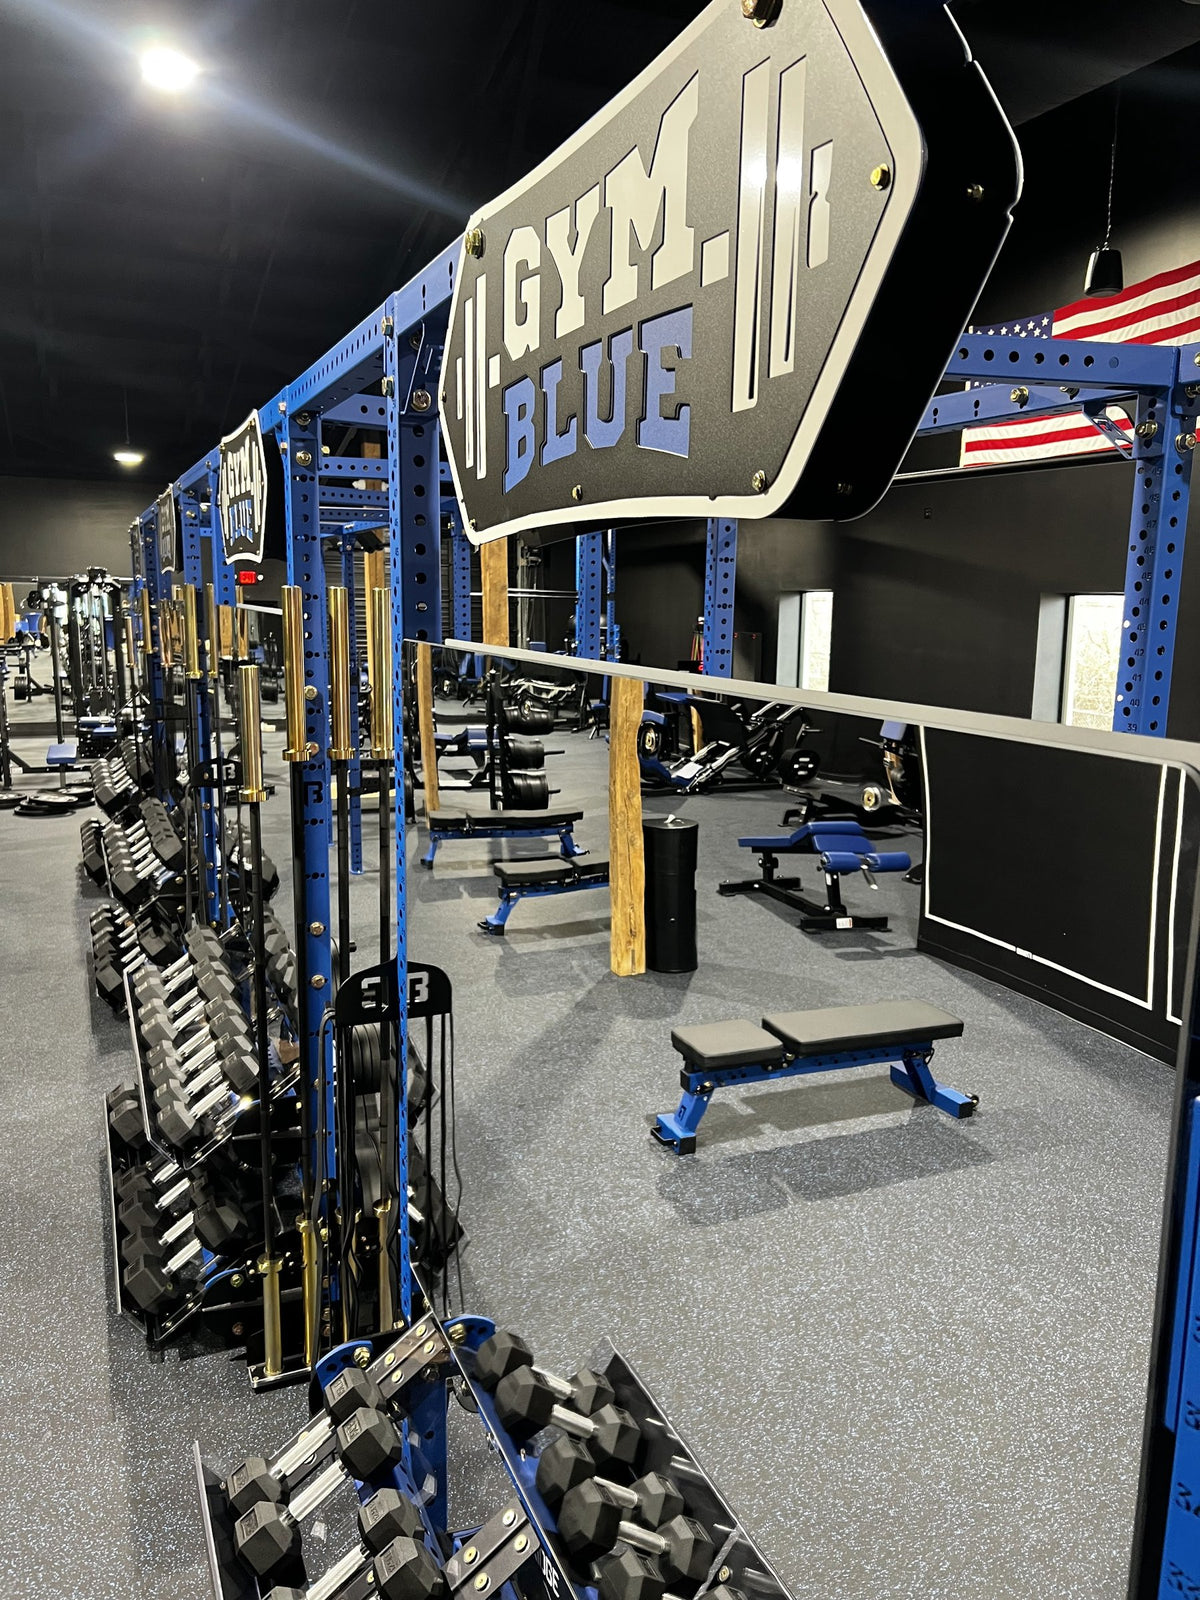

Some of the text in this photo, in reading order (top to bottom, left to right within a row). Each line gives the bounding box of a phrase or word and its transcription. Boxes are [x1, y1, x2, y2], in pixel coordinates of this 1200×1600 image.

[503, 69, 700, 359] GYM
[502, 302, 694, 495] BLUE
[227, 435, 251, 499] GYM
[228, 499, 254, 547] BLUE
